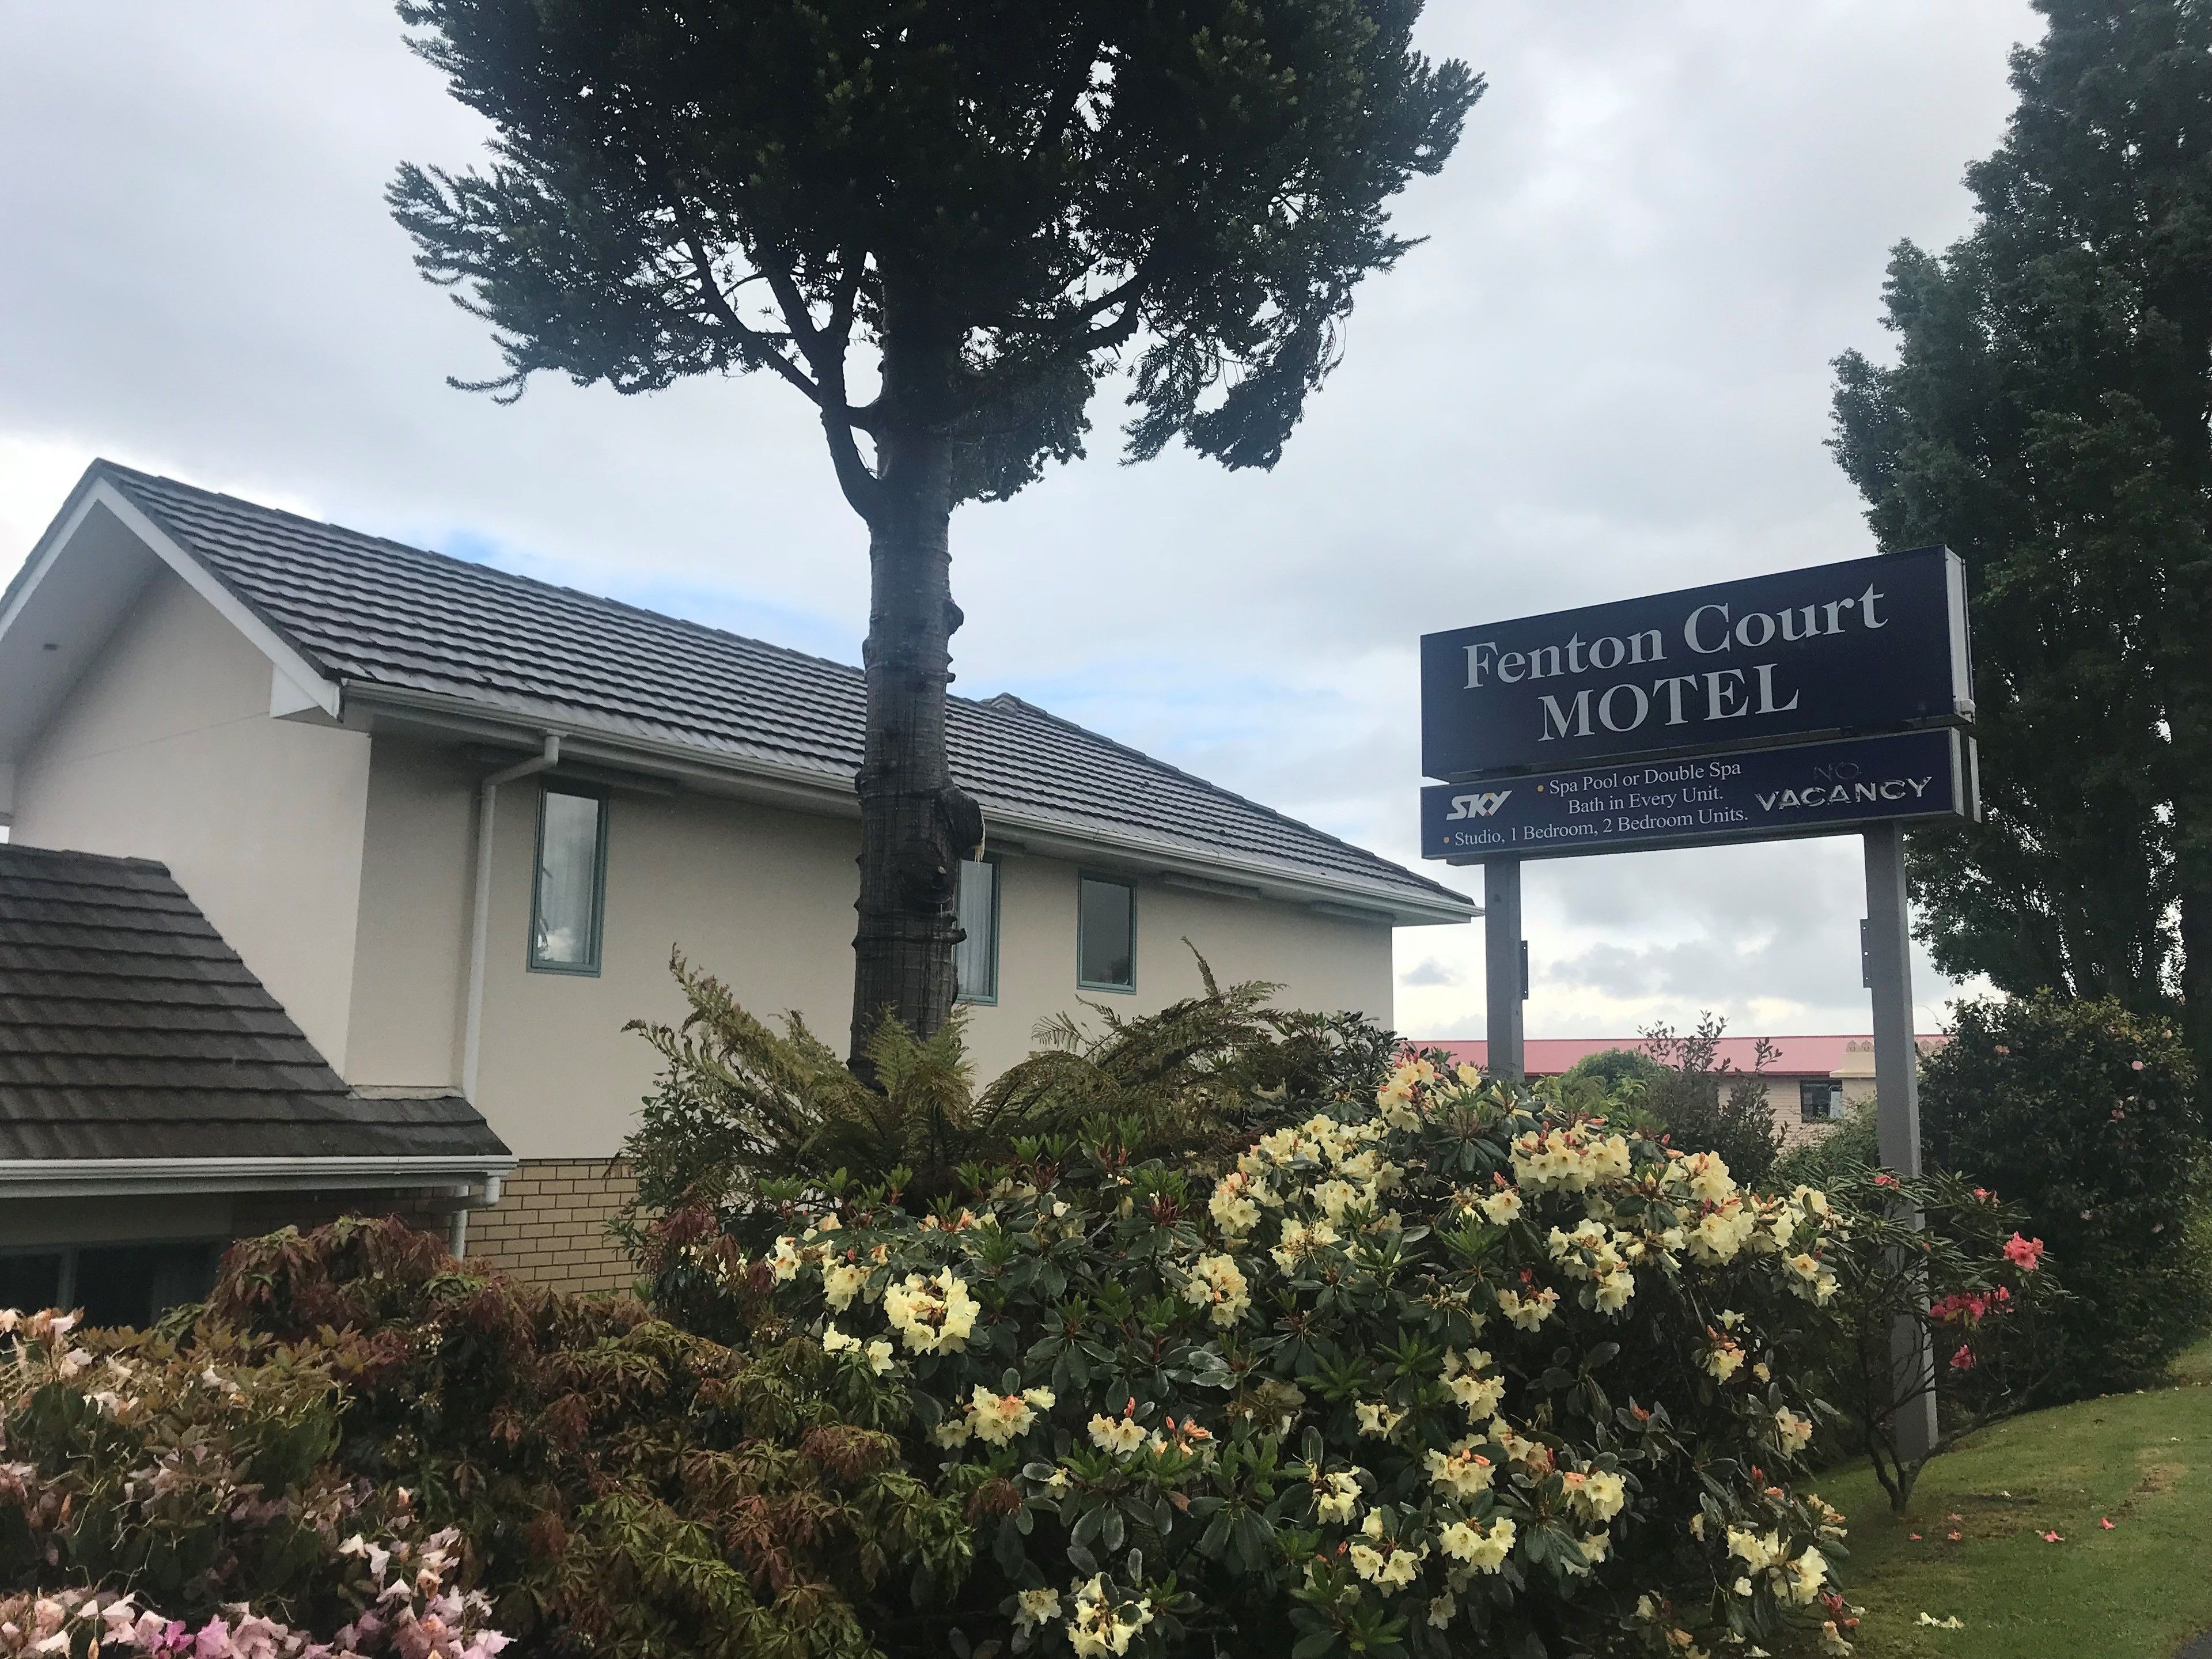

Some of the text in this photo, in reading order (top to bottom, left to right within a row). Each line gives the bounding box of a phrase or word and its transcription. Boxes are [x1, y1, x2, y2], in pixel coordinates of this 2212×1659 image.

[1462, 582, 1889, 690] Fenton Court
[1537, 662, 1800, 743] MOTEL
[1549, 762, 1741, 797] Spa Pool or Double Spa
[1754, 776, 1933, 812] VACANCY
[1445, 790, 1513, 821] SKY
[1567, 785, 1724, 815] Bath in Every Unit.
[1455, 806, 1748, 847] Studio, 1 Bedroom, 2 Bedroom Units.
